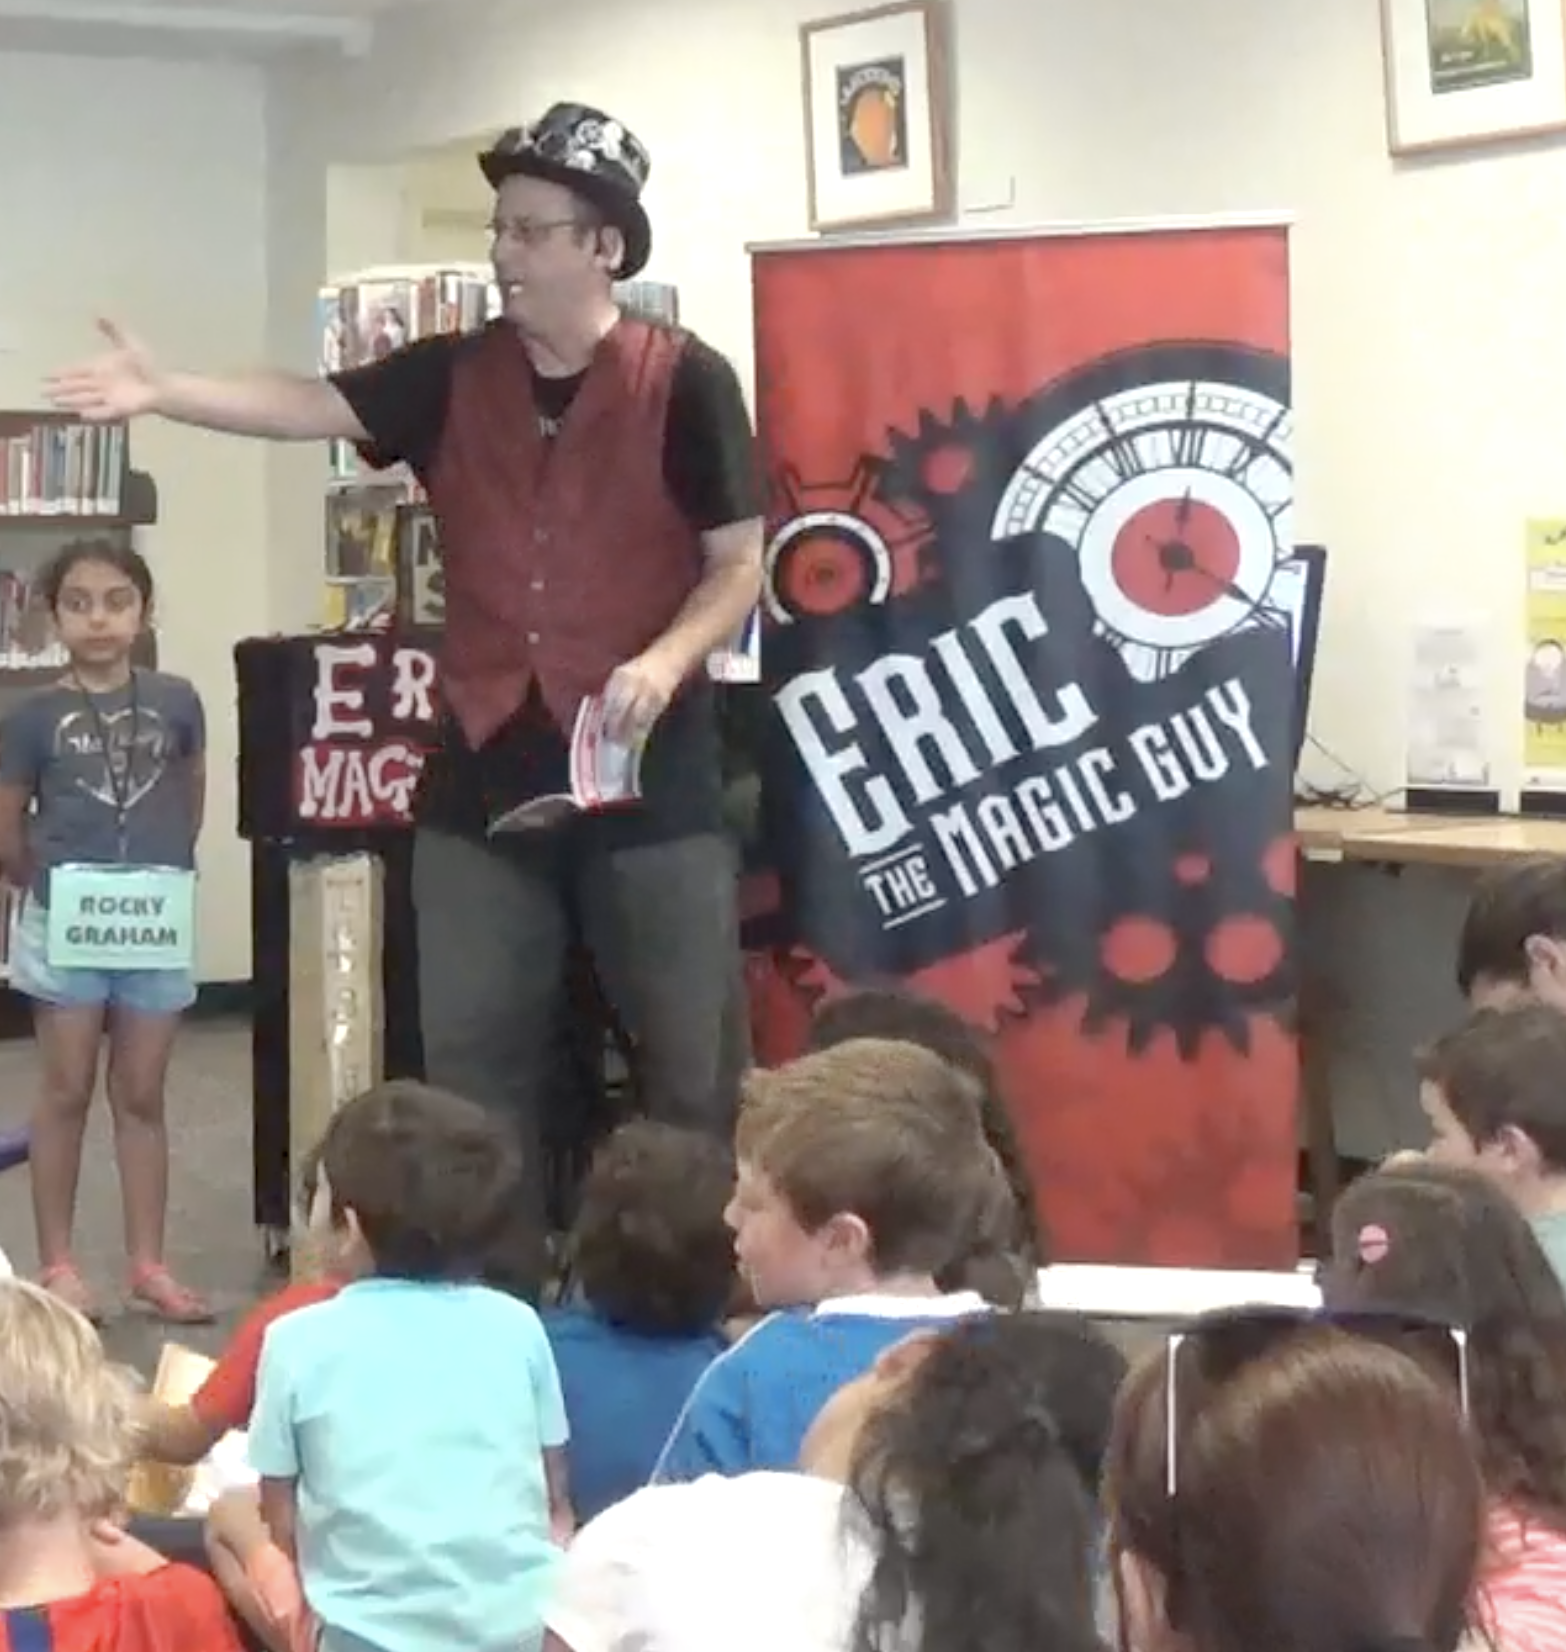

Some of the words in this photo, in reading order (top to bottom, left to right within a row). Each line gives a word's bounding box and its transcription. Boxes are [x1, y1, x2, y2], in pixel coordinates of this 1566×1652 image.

[312, 644, 436, 740] ER
[774, 590, 1098, 858] ERIC
[299, 744, 425, 819] MAG
[864, 861, 936, 915] THE
[929, 747, 1137, 898] MAGIC
[1128, 677, 1270, 802] GUY
[64, 925, 178, 947] GRAHAM
[79, 894, 167, 917] ROCKY
